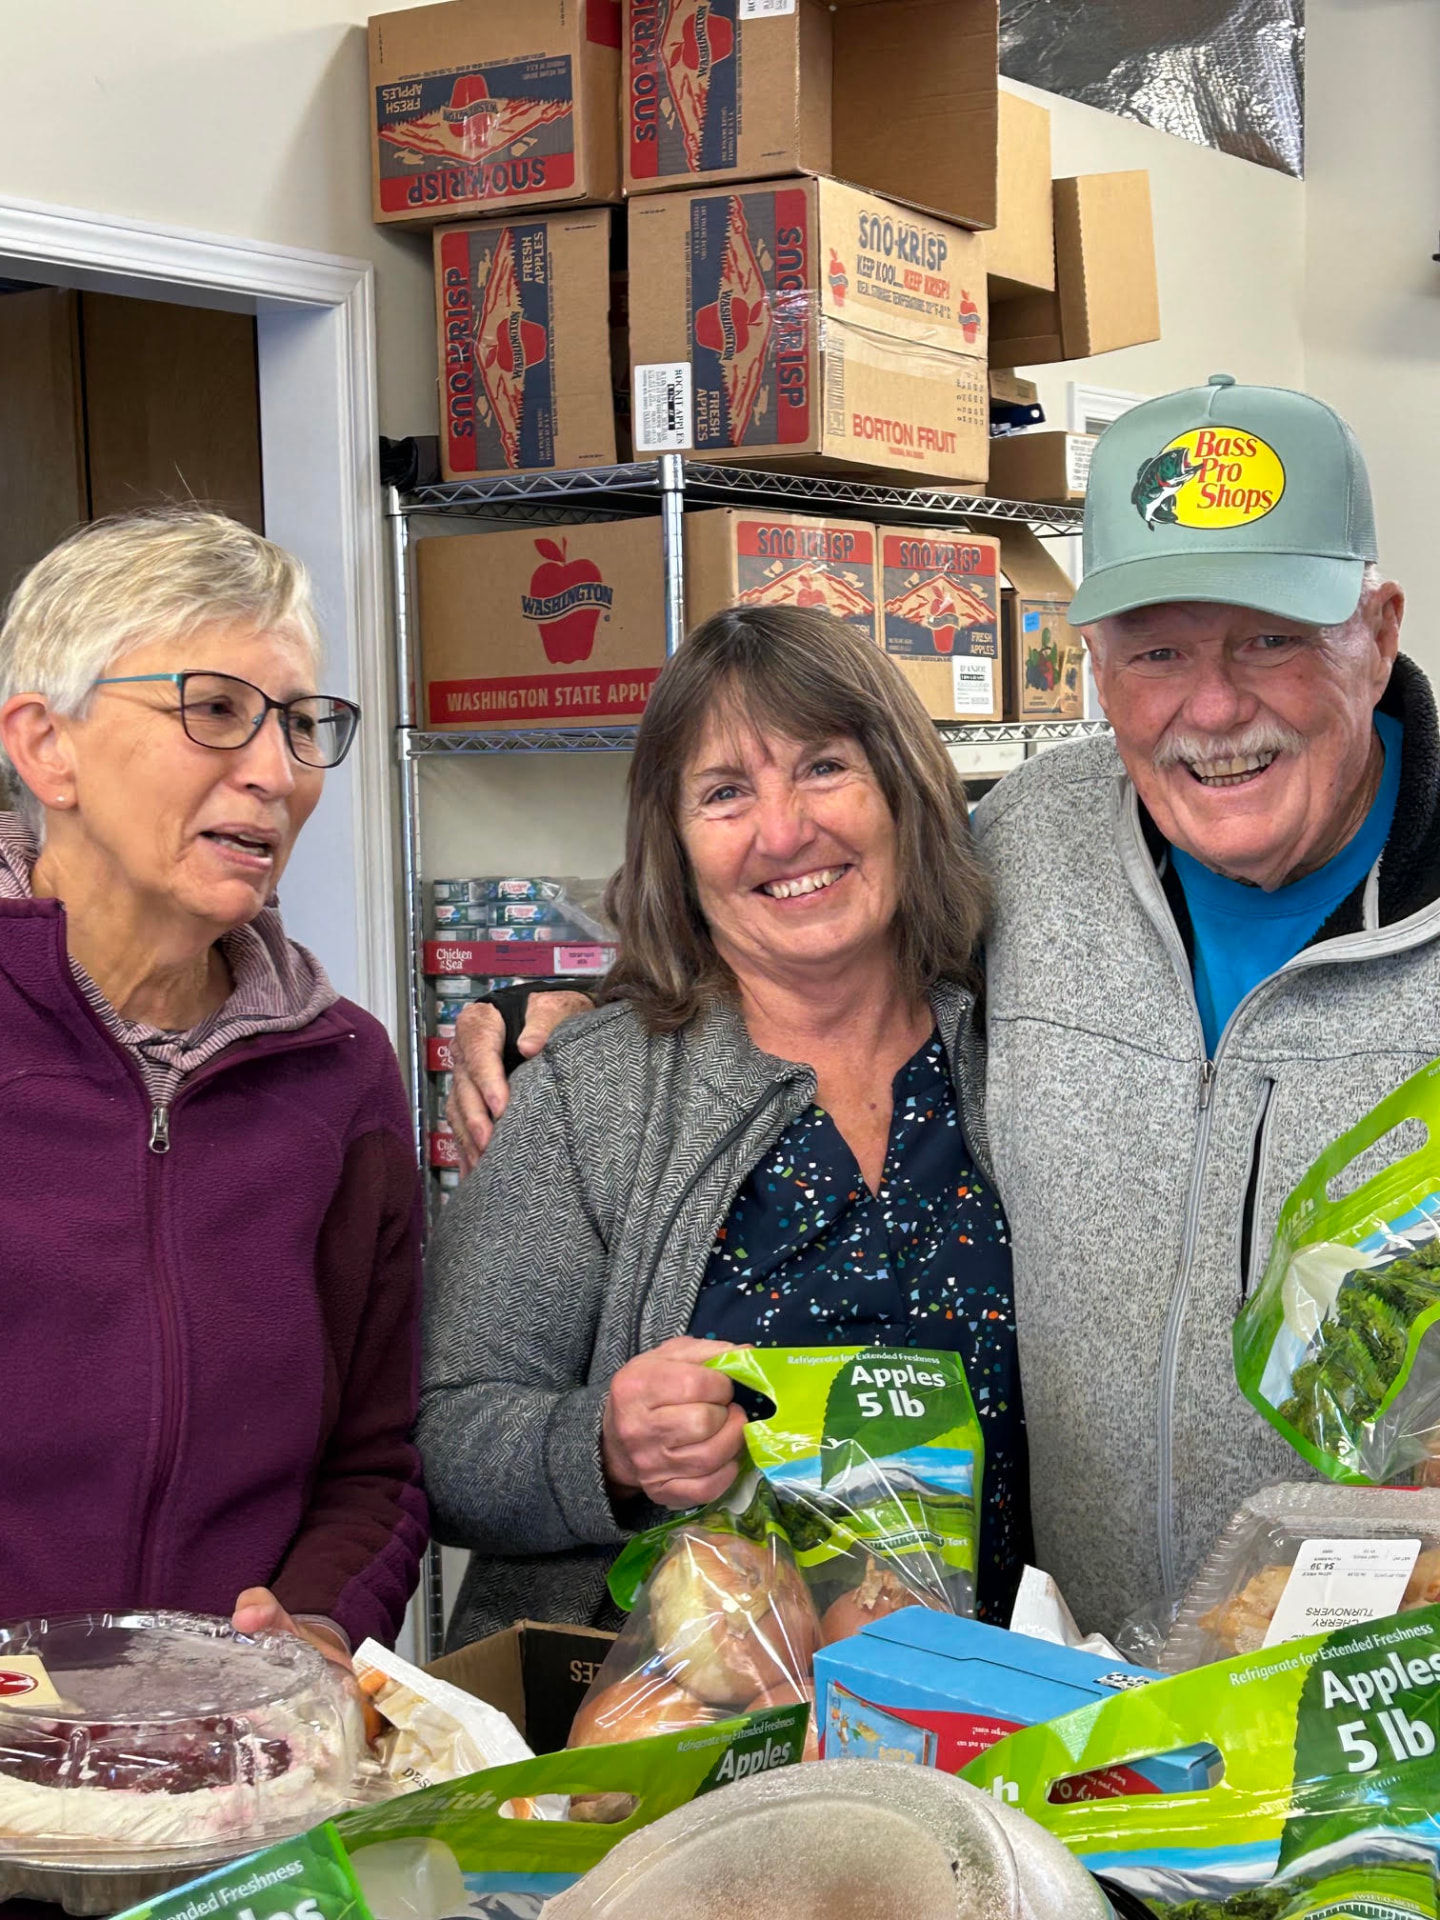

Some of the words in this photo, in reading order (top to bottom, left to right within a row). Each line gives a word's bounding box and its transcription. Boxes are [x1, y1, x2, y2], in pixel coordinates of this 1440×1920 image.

[630, 0, 657, 143] SNO-KRI
[382, 82, 423, 99] APPLES
[385, 98, 421, 114] FRESH
[522, 236, 533, 283] FRESH
[533, 231, 545, 284] APPLES
[721, 290, 737, 361] WASHINGTON
[510, 311, 526, 380] WASHINGTON
[697, 388, 709, 442] APPLES
[709, 390, 720, 437] FRESH
[853, 413, 914, 447] BORTON
[917, 426, 957, 454] FRUIT
[1194, 430, 1258, 458] Bass
[1198, 458, 1242, 483] Pro
[1197, 483, 1273, 514] Shops
[521, 583, 614, 616] WASHINGTON
[970, 644, 995, 656] APPLES
[971, 631, 993, 643] FRESH
[447, 687, 549, 712] WASHINGTON
[555, 684, 601, 707] STATE
[436, 948, 472, 961] Chicken
[445, 959, 463, 970] Sea
[850, 1364, 946, 1388] Apples
[857, 1392, 883, 1417] 5
[887, 1389, 925, 1417] lb
[1305, 1607, 1374, 1617] TURNOVERS
[1228, 1655, 1299, 1687] Refrigerate
[1300, 1652, 1318, 1666] for
[1319, 1635, 1374, 1660] Extended
[1373, 1623, 1434, 1647] Freshness
[1322, 1651, 1440, 1711] Apples
[1337, 1720, 1378, 1773] 5
[1376, 1708, 1436, 1761] lb
[716, 1737, 791, 1781] Apples
[402, 1767, 433, 1789] DES
[218, 1859, 304, 1906] Freshness
